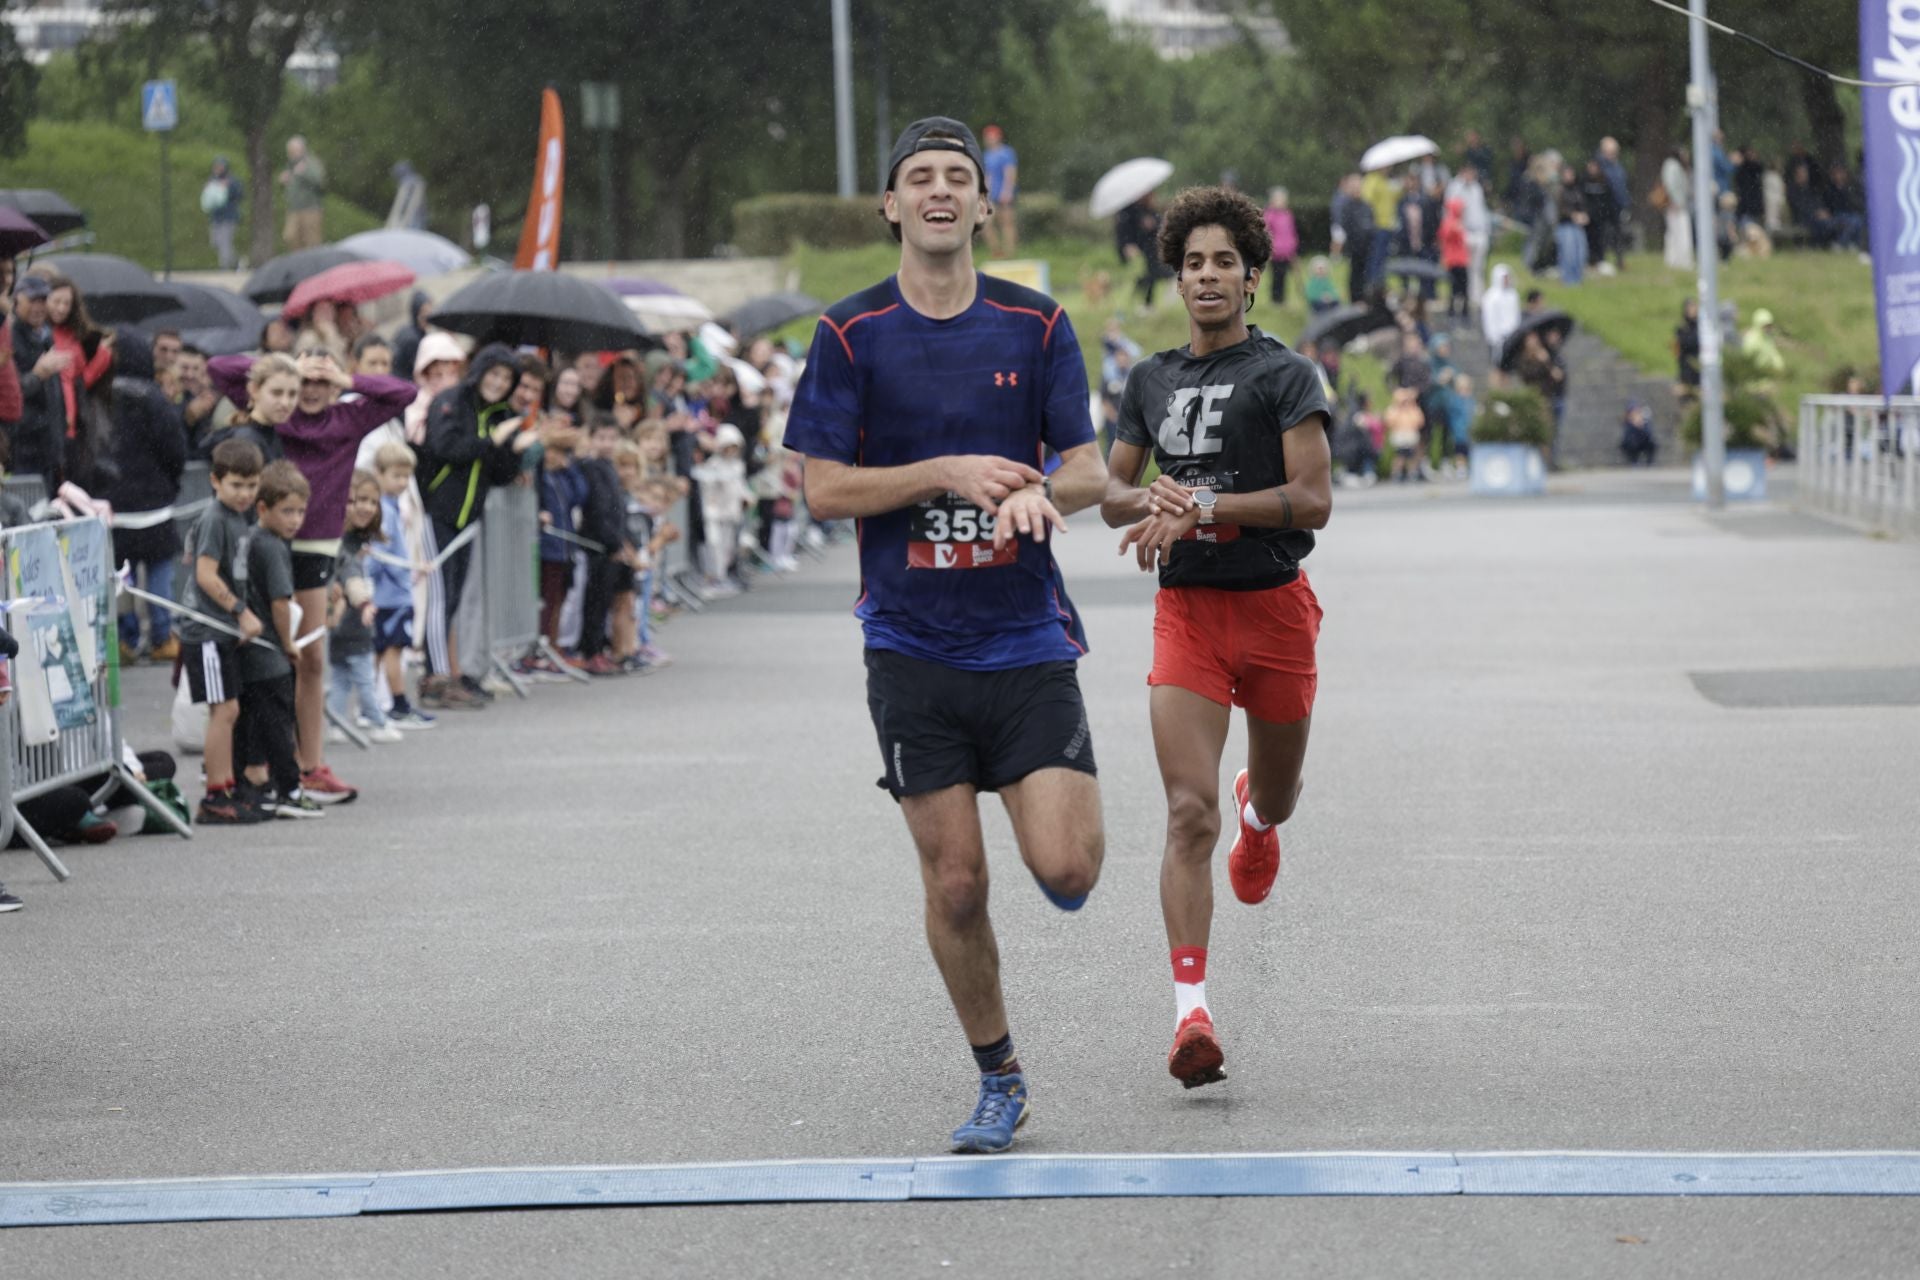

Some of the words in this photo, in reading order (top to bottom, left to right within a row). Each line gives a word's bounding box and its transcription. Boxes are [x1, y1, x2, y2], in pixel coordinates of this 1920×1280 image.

[1196, 476, 1216, 486] ELZO
[925, 509, 997, 542] 359
[1197, 532, 1217, 540] DIARIO
[894, 742, 905, 787] SALOMON
